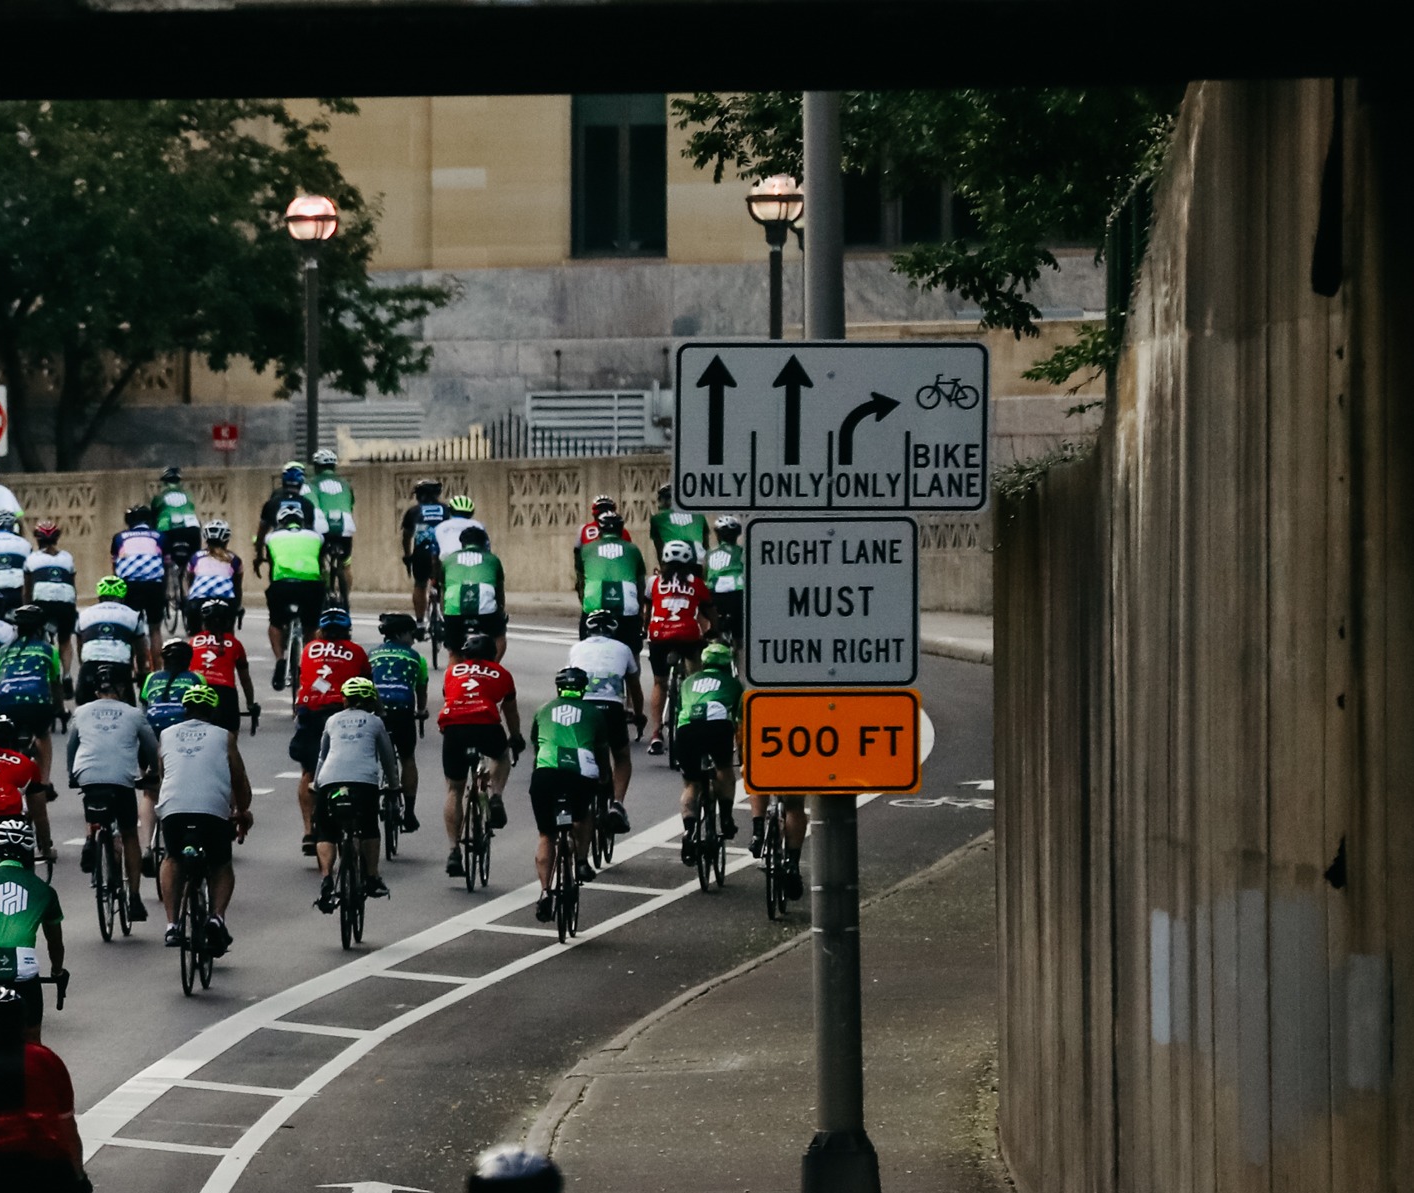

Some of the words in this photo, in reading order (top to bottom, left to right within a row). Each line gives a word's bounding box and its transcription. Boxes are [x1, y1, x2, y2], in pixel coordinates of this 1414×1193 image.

[913, 444, 980, 469] BIKE
[682, 472, 747, 498] ONLY
[758, 472, 824, 498] ONLY
[835, 472, 901, 498] ONLY
[913, 472, 980, 498] LANE
[760, 540, 832, 565] RIGHT
[841, 540, 903, 564] LANE
[788, 587, 874, 617] MUST
[308, 642, 353, 661] Ohio
[758, 638, 823, 663] TURN
[832, 638, 905, 664] RIGHT
[452, 663, 500, 678] Ohio
[760, 726, 839, 757] 500
[859, 726, 904, 756] FT
